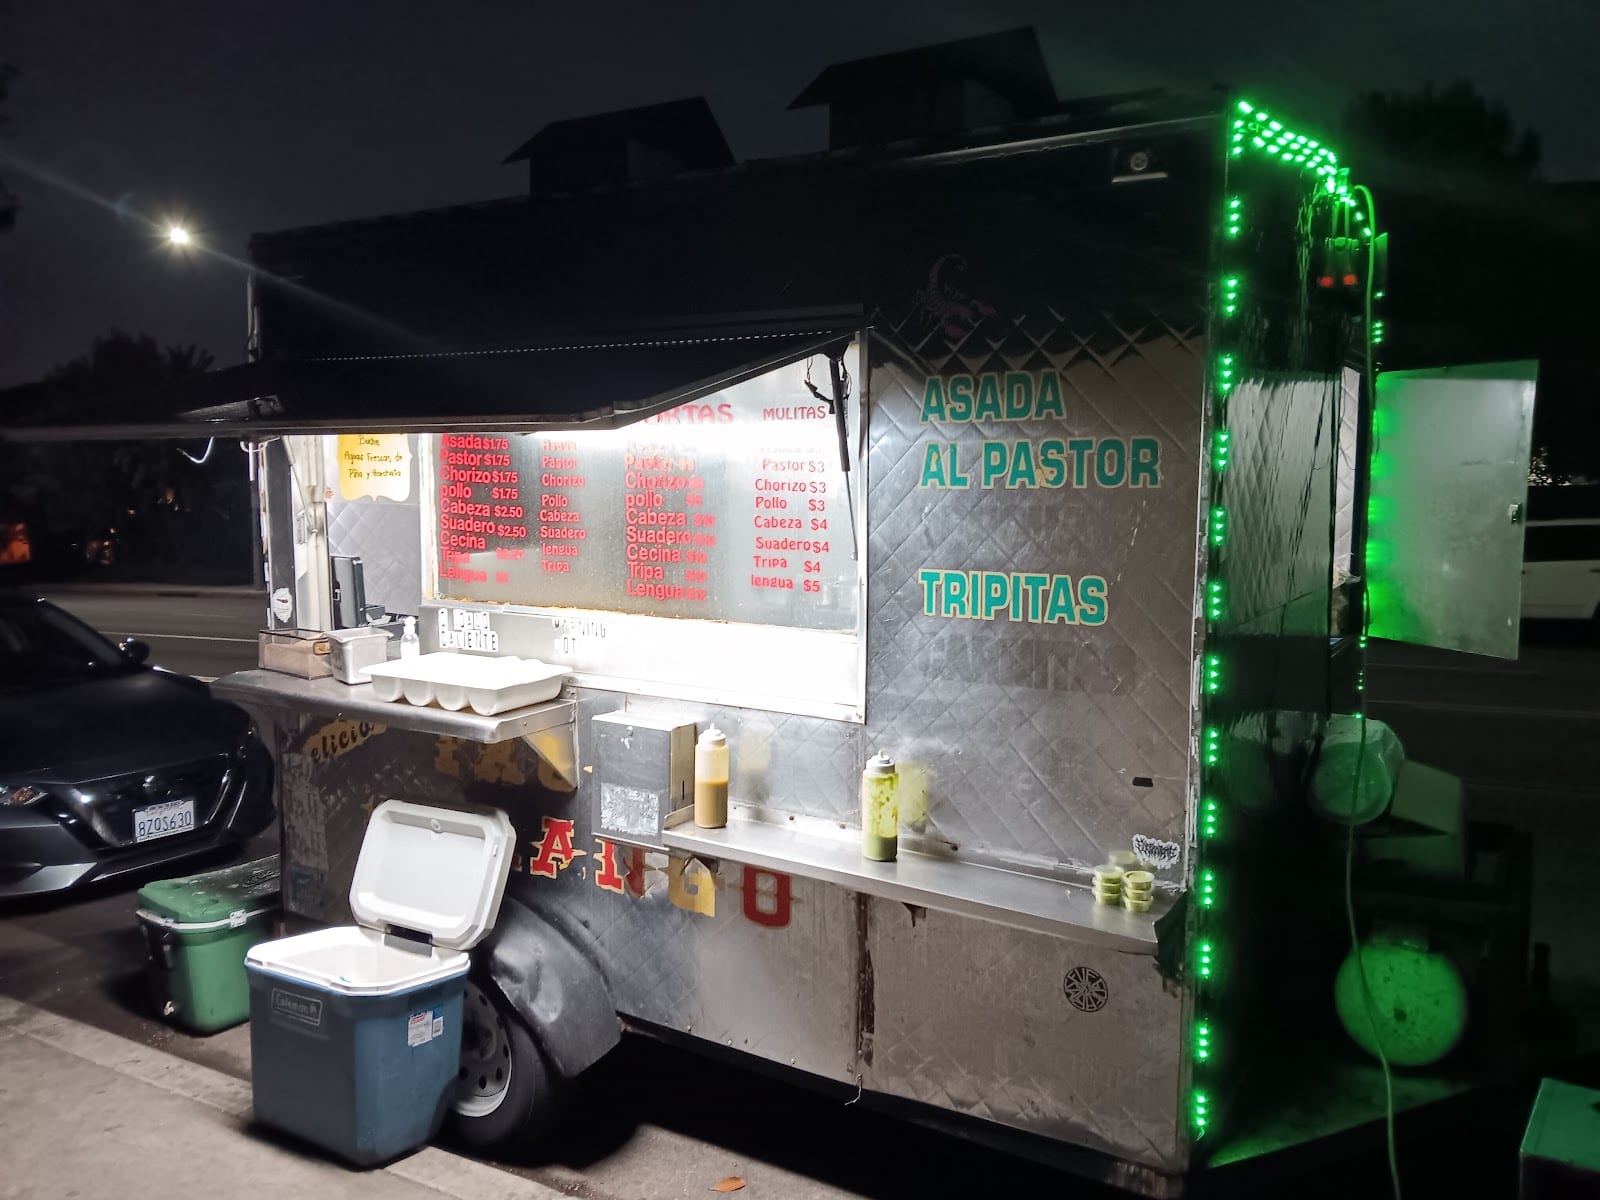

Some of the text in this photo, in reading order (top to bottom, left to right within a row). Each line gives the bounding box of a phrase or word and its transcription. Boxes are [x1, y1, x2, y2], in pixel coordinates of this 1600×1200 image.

[919, 368, 1067, 424] ASADA
[763, 405, 826, 421] MULITAS
[482, 438, 509, 450] $1.75
[439, 449, 511, 467] Pastor $1.75
[541, 455, 578, 470] Pastor
[762, 458, 825, 473] Pastor $3
[918, 435, 1162, 490] AL PASTOR
[439, 465, 519, 484] Chorizo $1.75
[541, 473, 586, 488] Chorizo
[624, 472, 685, 490] Chorizo
[439, 482, 519, 500] pollo $1.75
[755, 478, 827, 494] Chorizo $3
[439, 498, 523, 519] Cabeza $2.50
[541, 494, 569, 508] Pollo
[624, 490, 664, 509] pollo
[755, 496, 826, 512] Pollo $3
[539, 509, 581, 523] Cabeza
[625, 508, 687, 526] Cabeza
[754, 515, 828, 531] Cabeza $4
[439, 514, 527, 538] Suadero $2.50
[539, 525, 587, 540] Suadero
[626, 525, 692, 545] Suadero
[439, 530, 486, 549] Cecina
[755, 537, 830, 553] Suadero $4
[626, 544, 682, 562] Cecina
[541, 559, 571, 573] Tripa
[627, 561, 664, 581] Tripa
[753, 556, 821, 574] Tripa $4
[626, 580, 685, 601] Lengua
[802, 579, 821, 593] $5
[918, 568, 1109, 627] TRIPITAS
